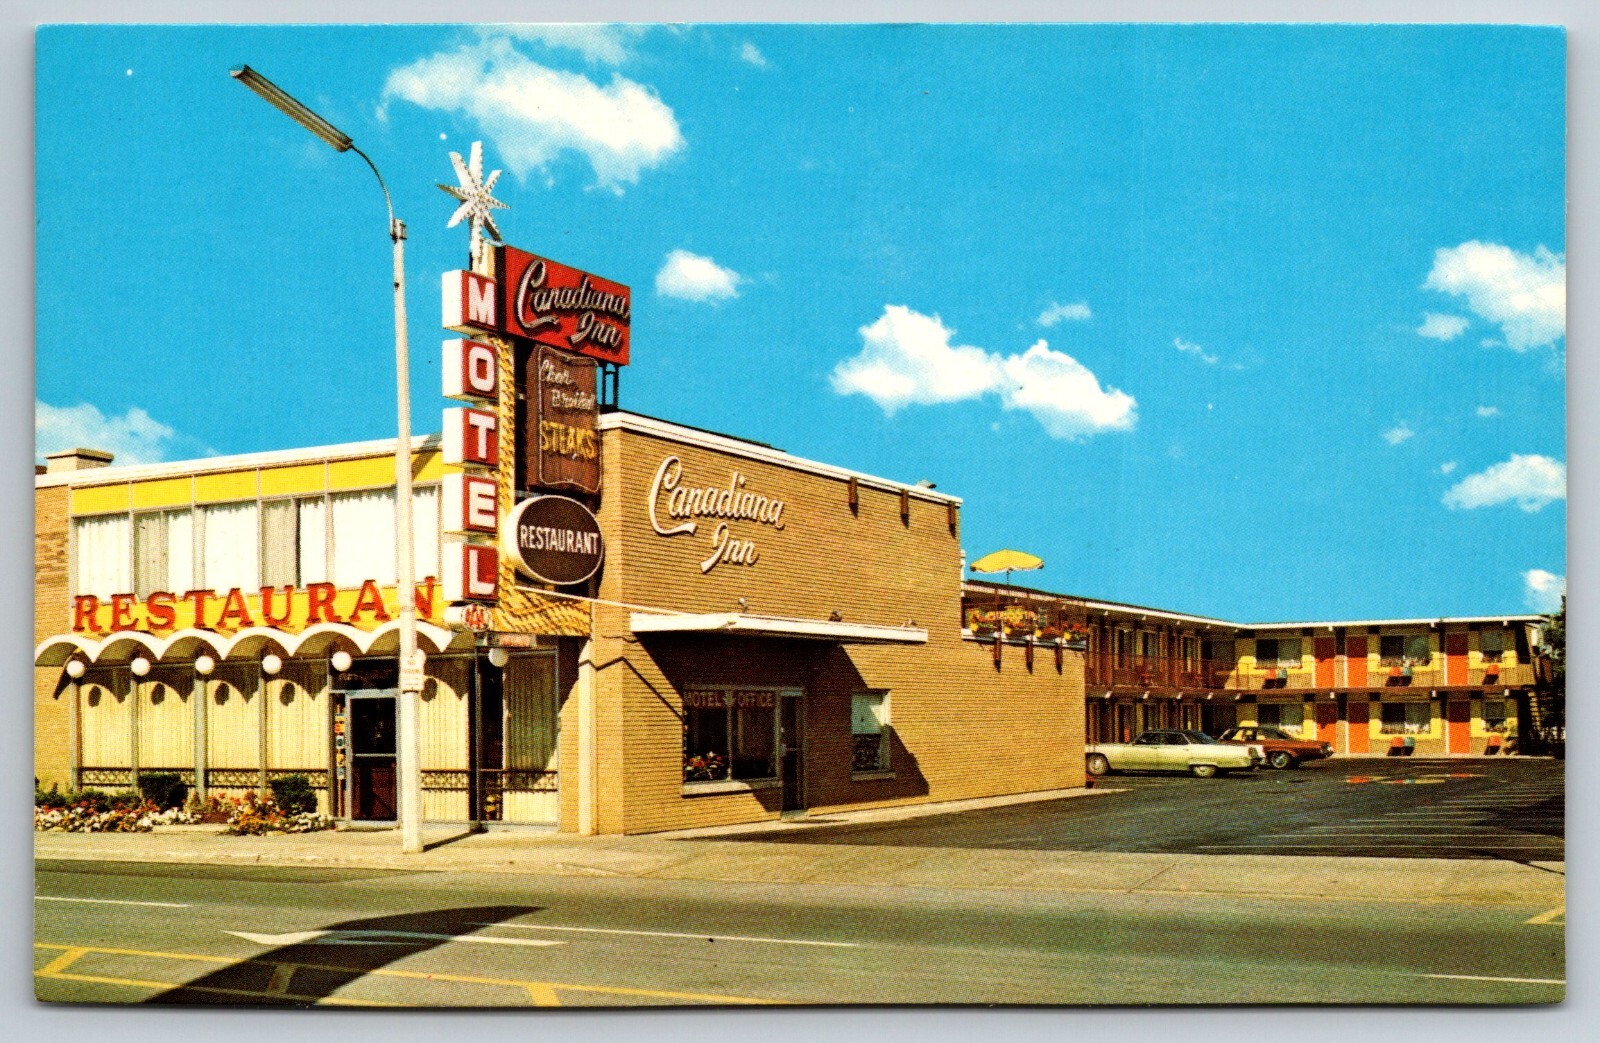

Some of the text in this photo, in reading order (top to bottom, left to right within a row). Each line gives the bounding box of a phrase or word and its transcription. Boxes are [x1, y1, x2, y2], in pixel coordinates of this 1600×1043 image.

[516, 259, 629, 329] Canadiana
[570, 312, 622, 347] Inn
[467, 276, 496, 596] MOTEL
[541, 420, 597, 459] STEAKS
[649, 455, 785, 535] Canadiana
[520, 525, 599, 555] RESTAURANT
[700, 522, 759, 573] Inn
[738, 691, 774, 707] OFFICE
